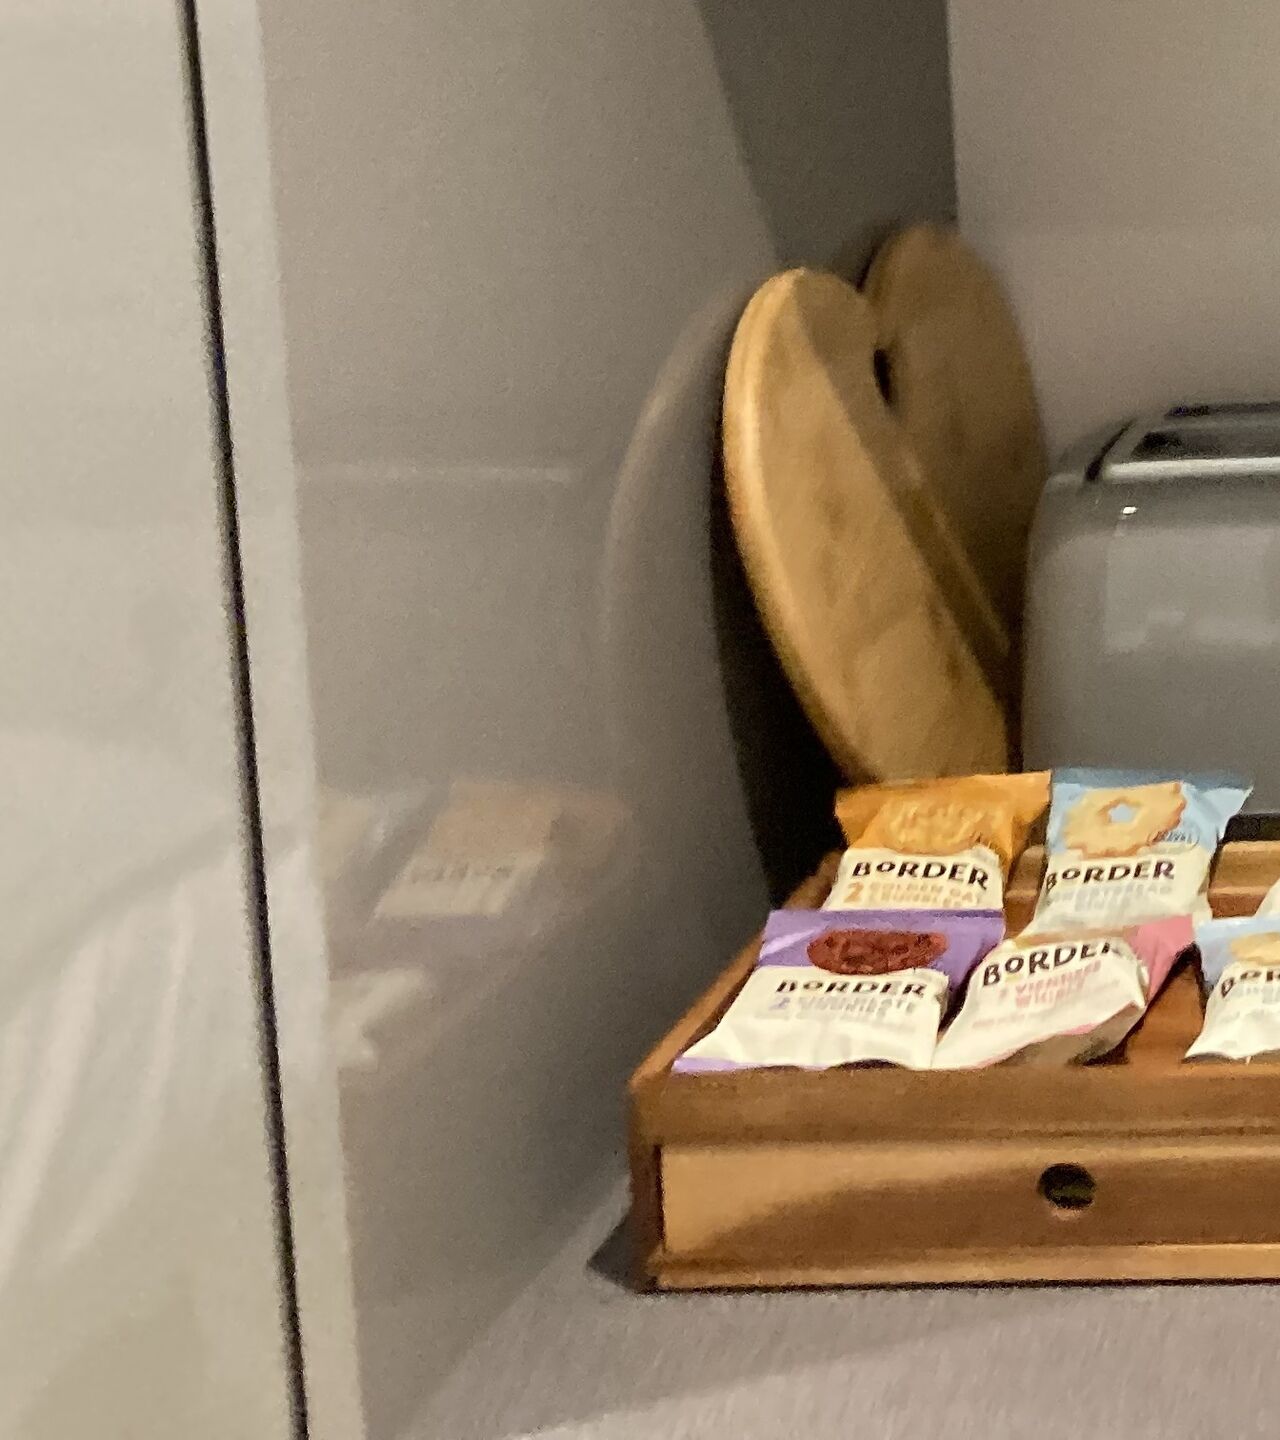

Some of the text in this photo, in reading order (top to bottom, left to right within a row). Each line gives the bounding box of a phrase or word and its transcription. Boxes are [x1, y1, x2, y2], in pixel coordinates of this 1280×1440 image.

[852, 861, 989, 891] BORDER
[1046, 860, 1174, 894] BORDER
[776, 980, 926, 999] BORDER
